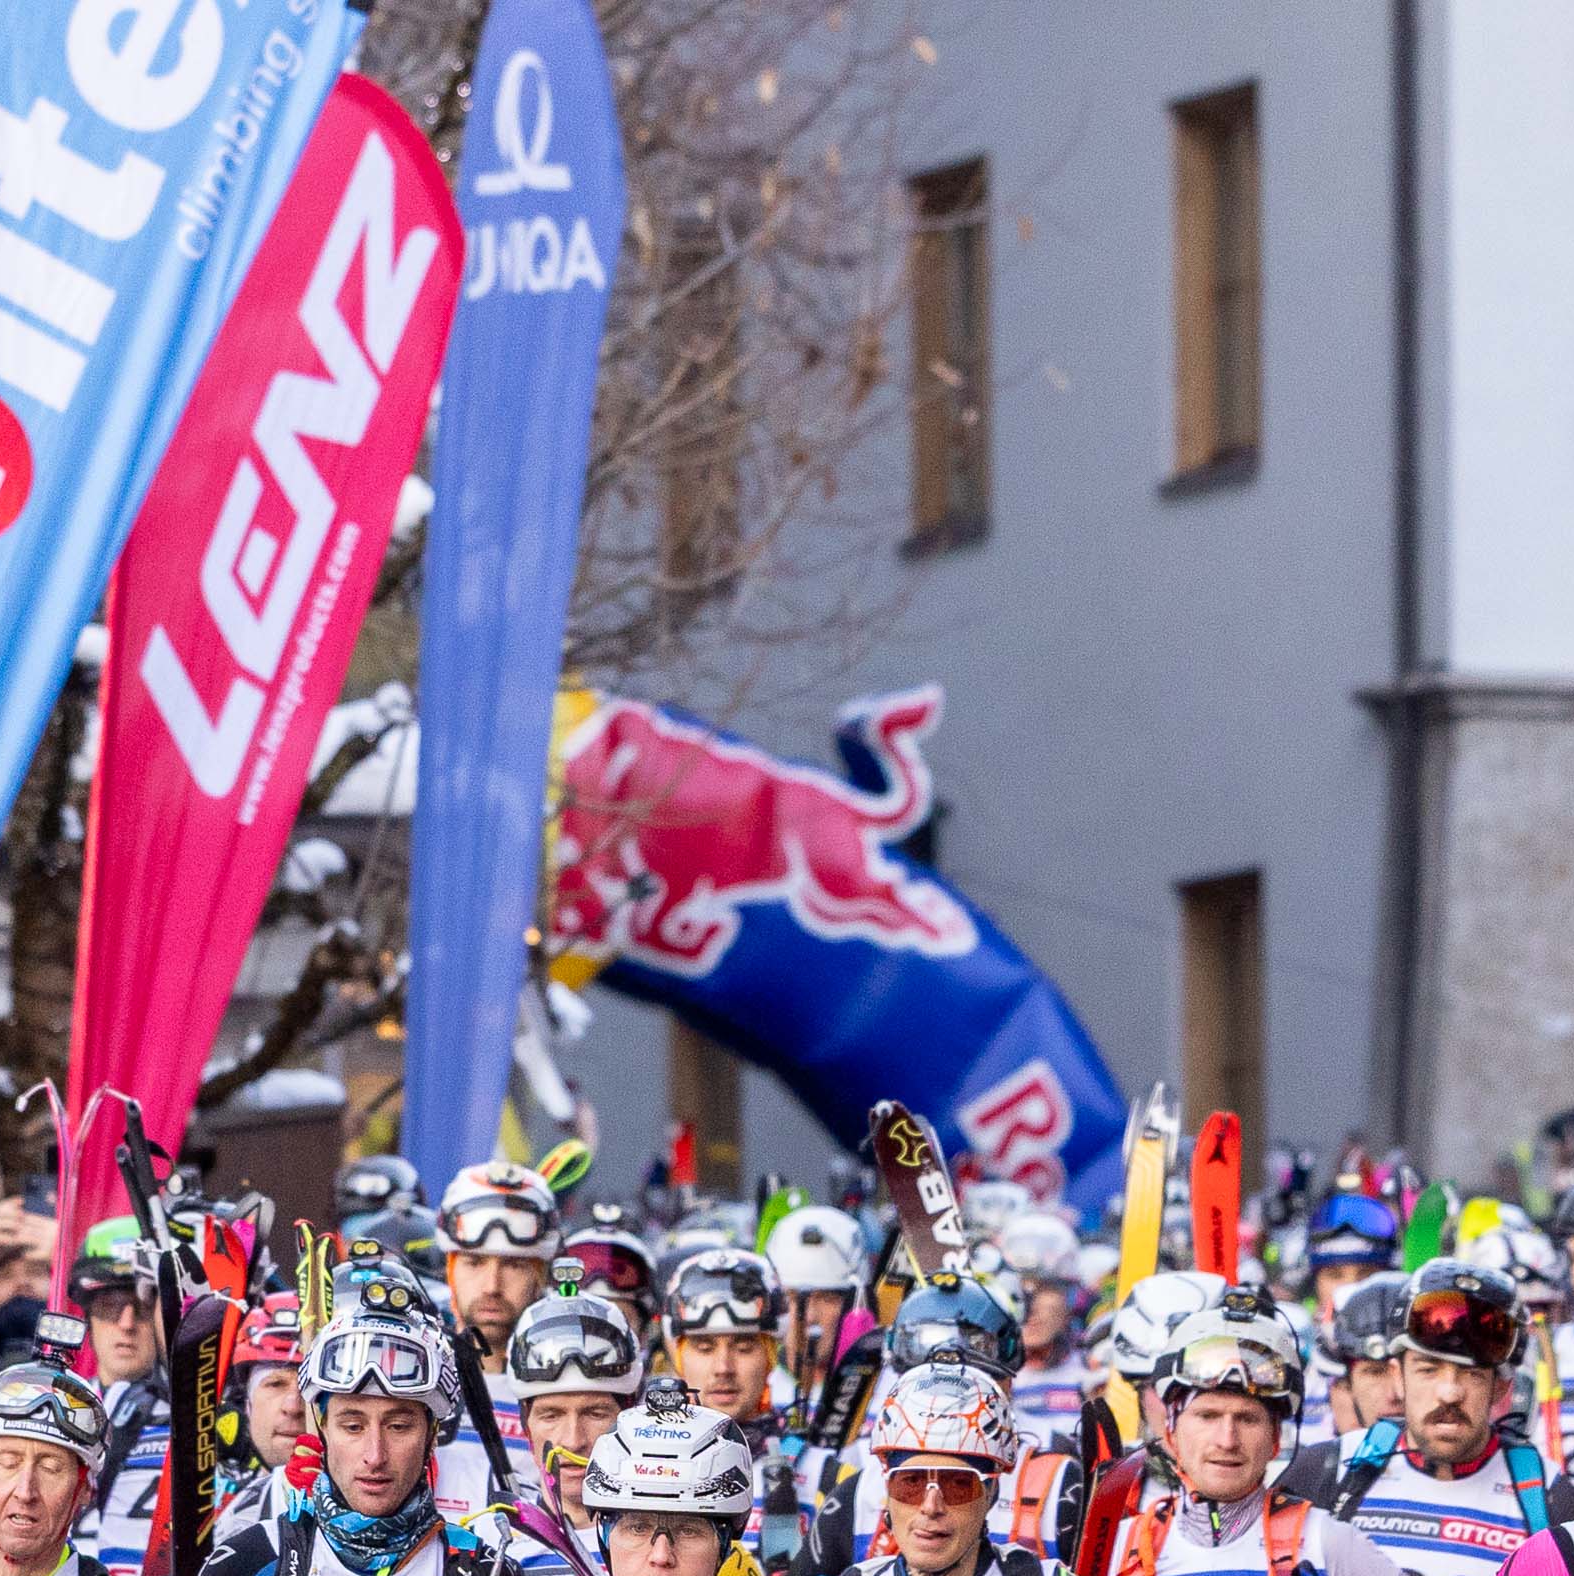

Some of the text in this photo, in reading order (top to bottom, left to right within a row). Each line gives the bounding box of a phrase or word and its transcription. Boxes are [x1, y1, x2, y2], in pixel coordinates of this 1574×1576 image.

[140, 130, 441, 798] LENZ
[195, 1333, 218, 1472] SPORTIVA
[633, 1426, 692, 1441] TRENTINO
[634, 1464, 649, 1476] Val
